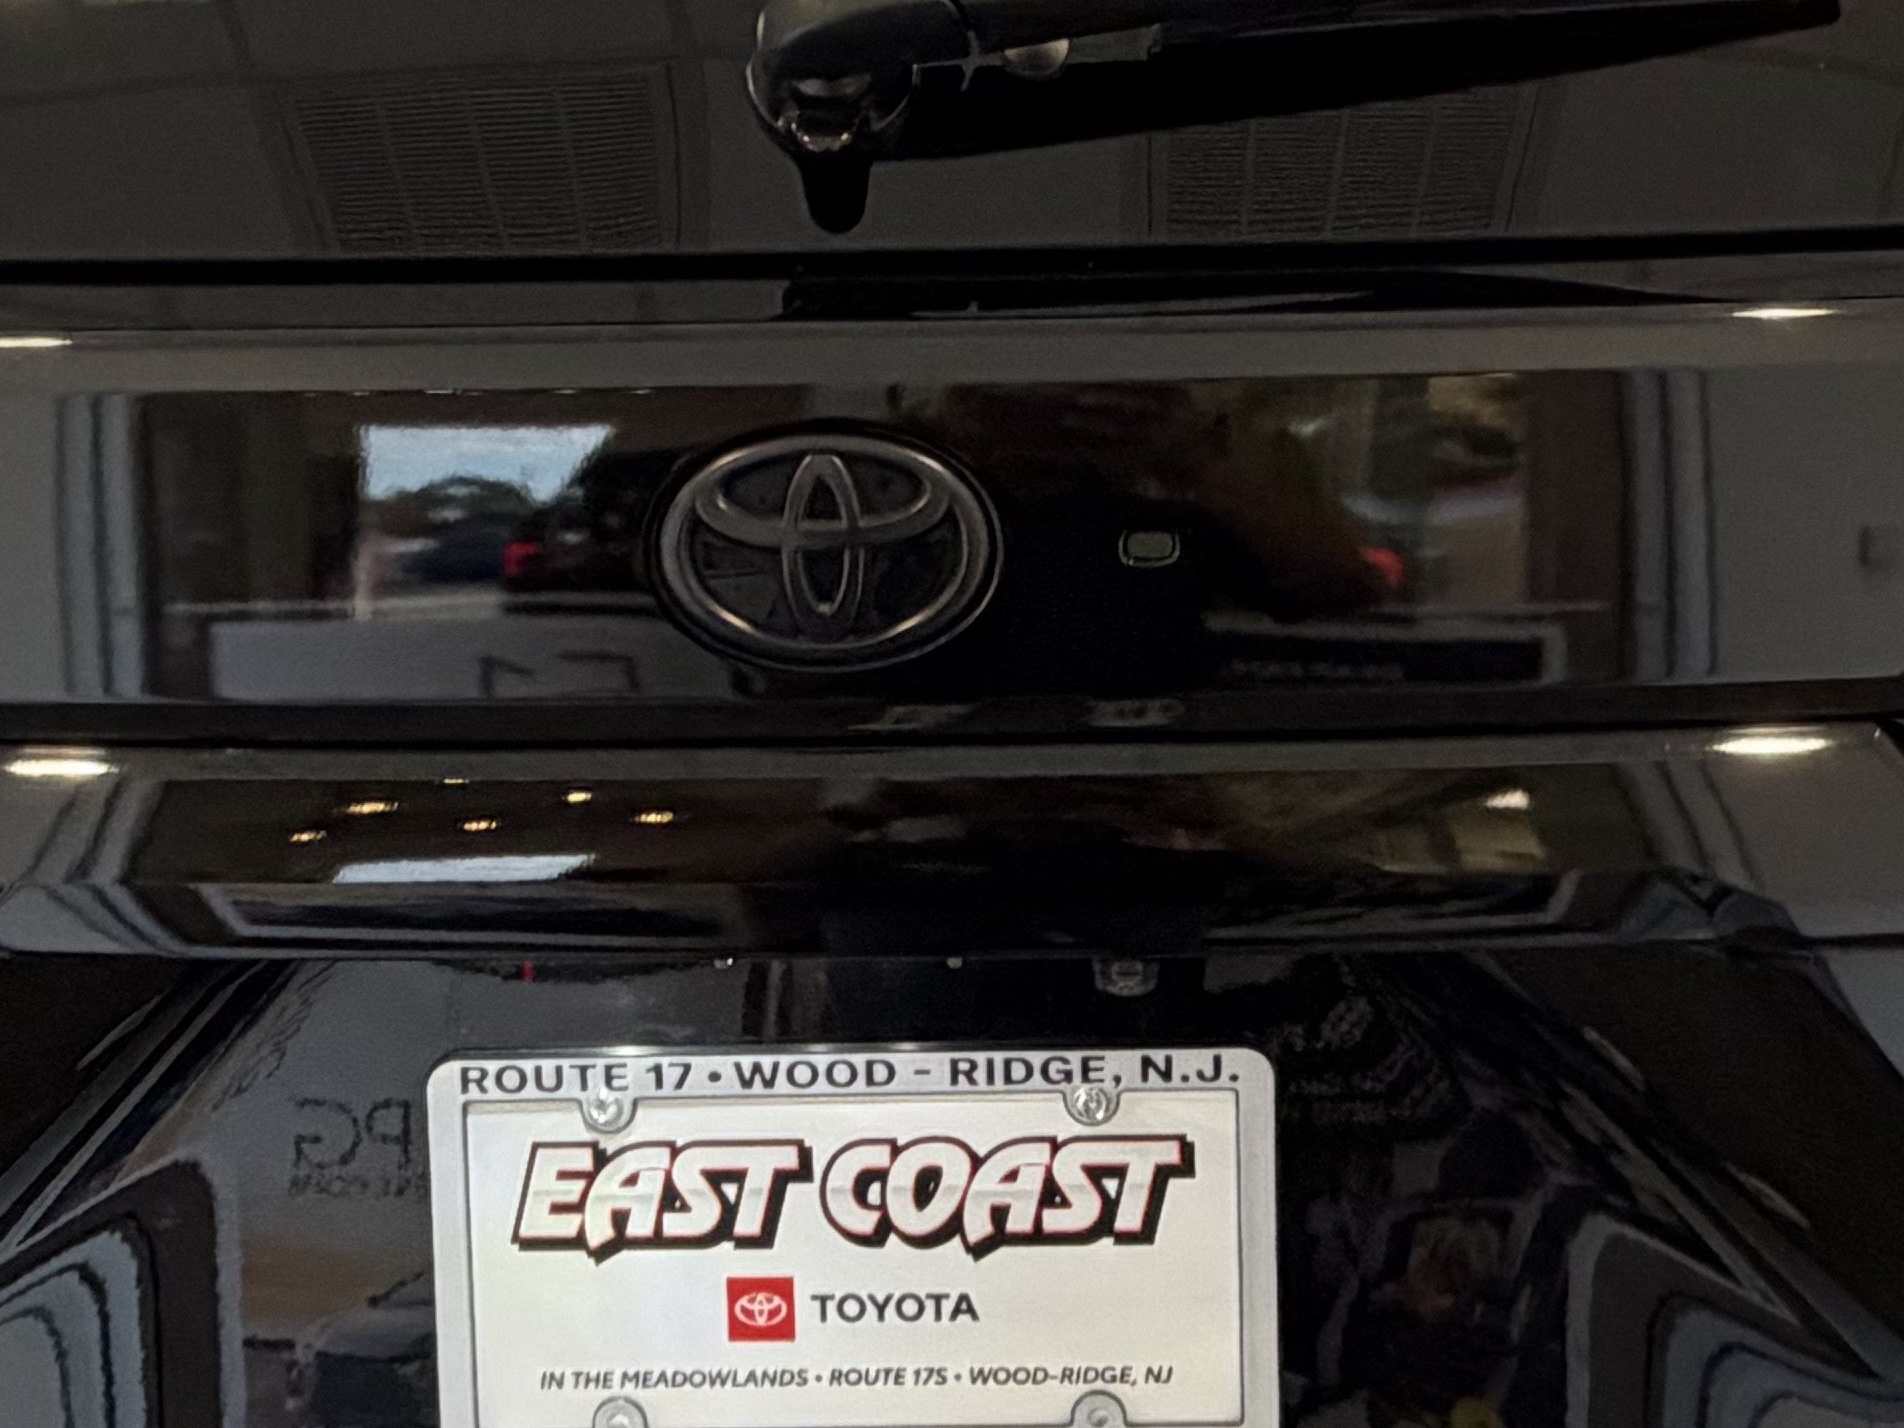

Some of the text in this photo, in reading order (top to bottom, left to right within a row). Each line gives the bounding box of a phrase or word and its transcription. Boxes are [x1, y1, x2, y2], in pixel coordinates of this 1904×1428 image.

[459, 1060, 631, 1096] ROUTE
[645, 1060, 694, 1091] 17
[732, 1058, 897, 1092] WOOD
[948, 1054, 1124, 1089] RIDGE,
[1139, 1052, 1241, 1084] N.J.
[510, 1132, 1197, 1267] EAST COAST
[809, 1290, 981, 1324] TOYOTA
[540, 1364, 1175, 1391] IN THE MEADOWLANDS ROUTE 17S WOOD-RIDGE, NJ
